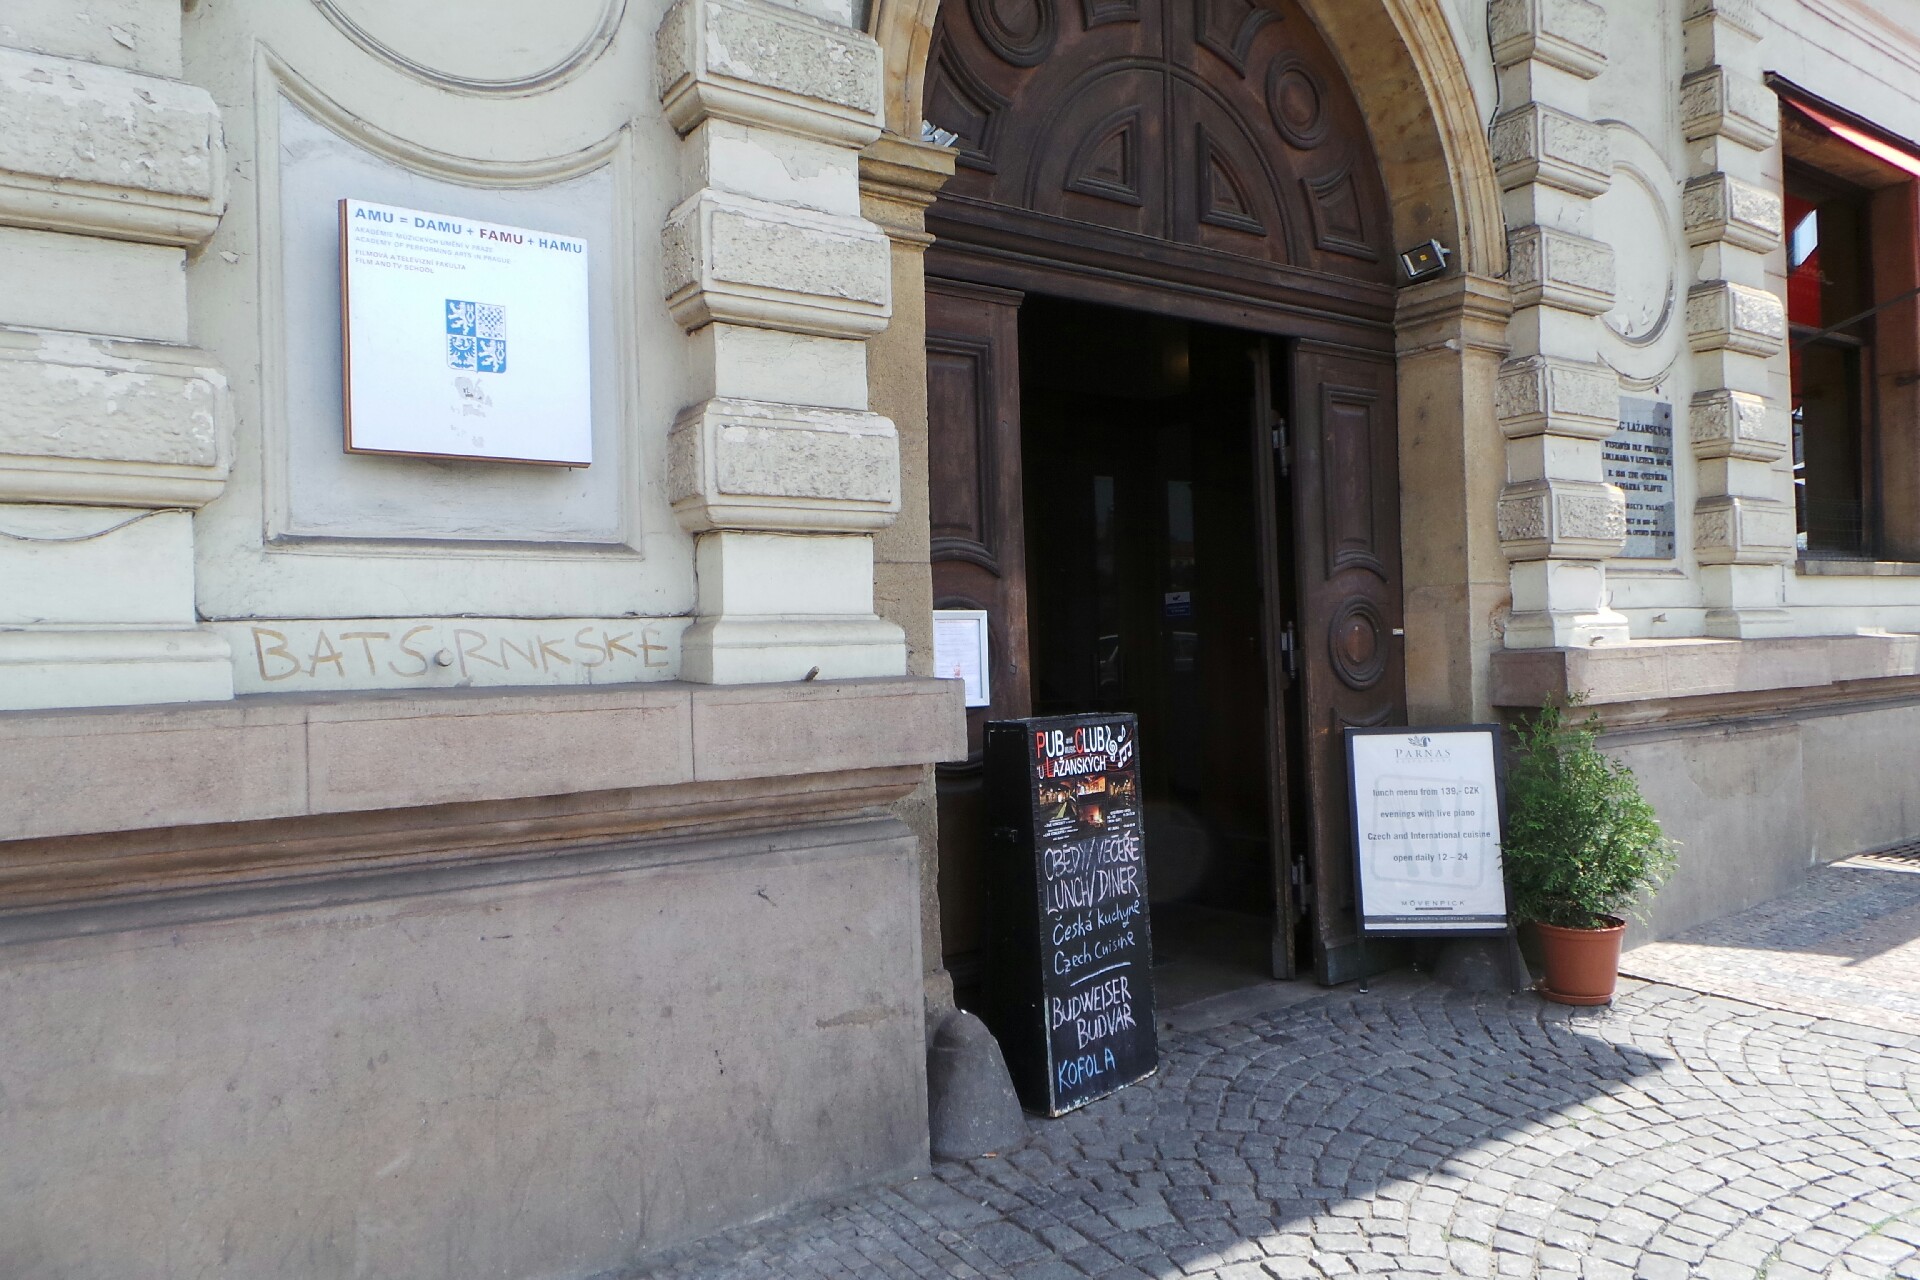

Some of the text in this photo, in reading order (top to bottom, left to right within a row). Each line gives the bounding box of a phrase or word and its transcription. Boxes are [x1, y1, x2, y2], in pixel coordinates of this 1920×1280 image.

[355, 208, 394, 224] AMU
[414, 217, 462, 235] DAMU
[479, 228, 523, 245] FAMU
[539, 238, 583, 254] HAMU
[355, 226, 393, 238] AKADEMIE
[355, 236, 393, 247] ACADEMY
[406, 243, 452, 255] PERFORMING
[454, 250, 472, 259] ARTS
[483, 254, 512, 265] PRAGUE
[355, 256, 373, 265] FILM
[374, 259, 391, 268] AND
[404, 264, 435, 274] SCHOOL
[436, 260, 466, 271] FAKULTA
[1036, 729, 1065, 758] PUB
[1075, 726, 1105, 754] CLUB
[1394, 748, 1451, 759] PARNAS
[1372, 788, 1394, 797] lunch
[1396, 789, 1418, 797] menu
[1420, 788, 1438, 796] from
[1464, 786, 1480, 795] CZK
[1380, 809, 1476, 819] evenings with live piano
[1367, 830, 1491, 840] Czech and International cuisine
[1393, 854, 1413, 863] open
[1415, 853, 1435, 863] daily
[1437, 853, 1449, 861] 12
[1457, 852, 1469, 861] 24
[1052, 911, 1093, 946] Česká
[1054, 931, 1135, 975] Czech Cuisine
[1053, 976, 1132, 1030] BUDWEISER
[1077, 1003, 1137, 1050] BUDVAR
[1058, 1047, 1116, 1093] KOFOLA
